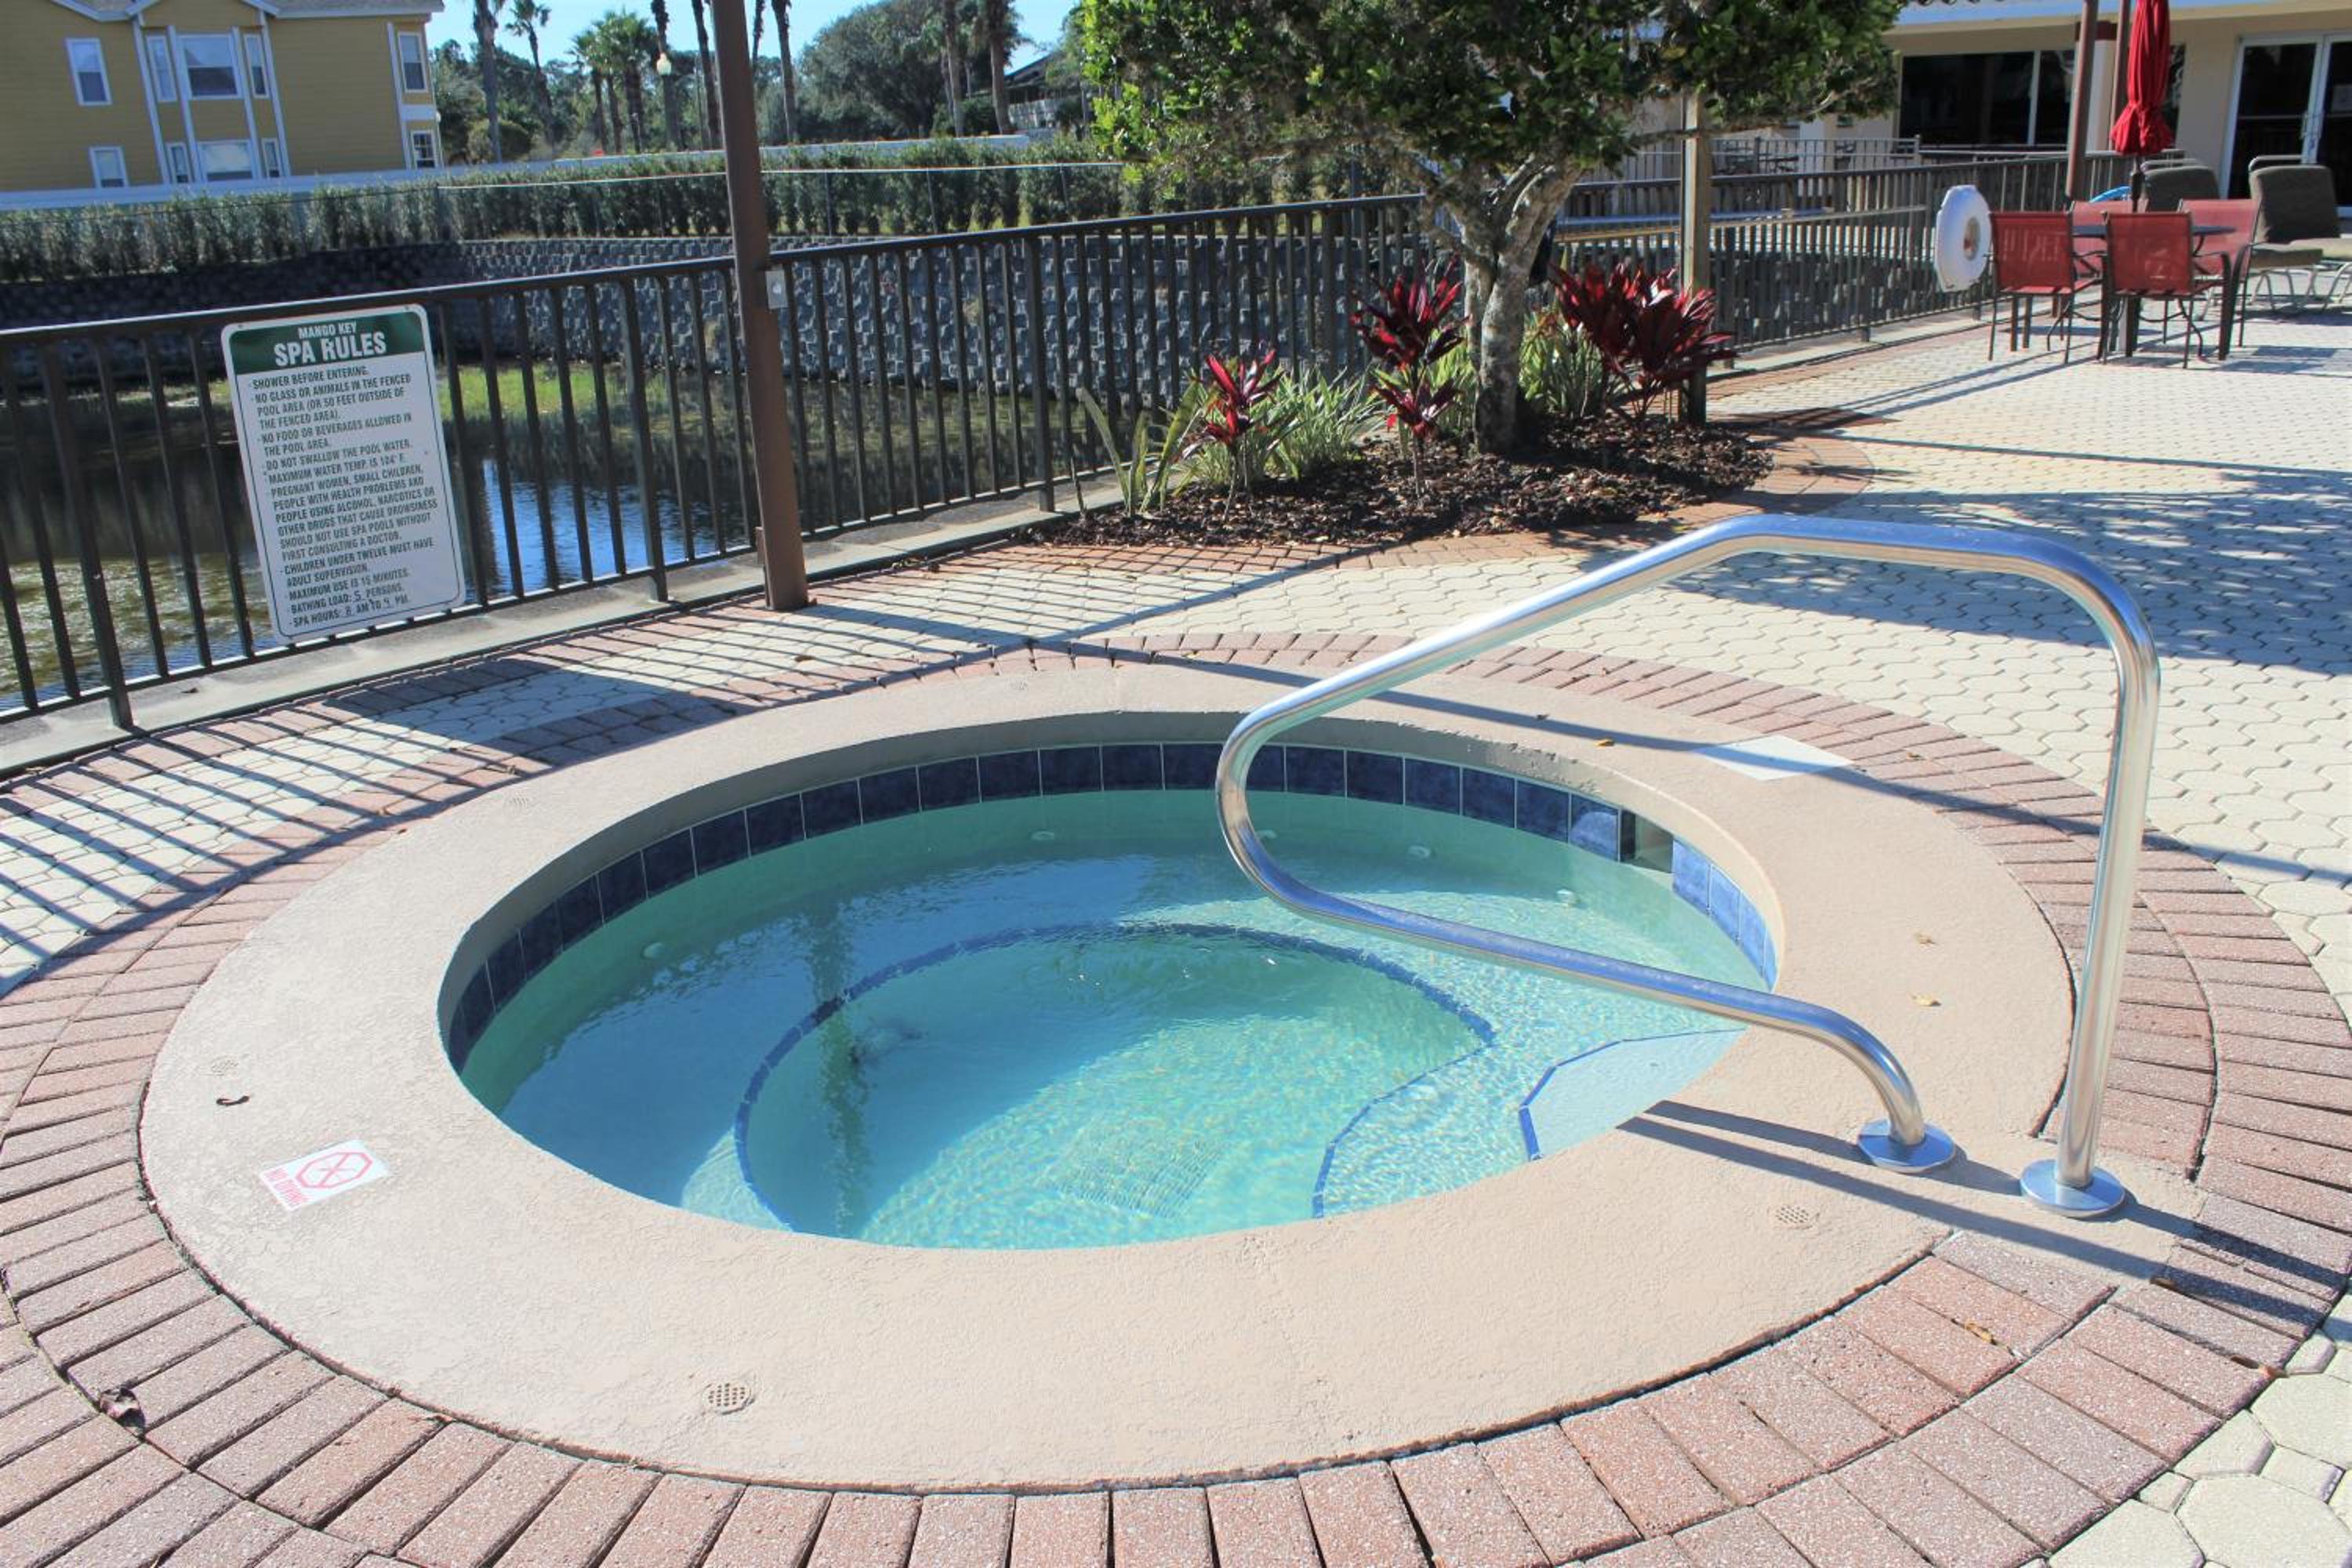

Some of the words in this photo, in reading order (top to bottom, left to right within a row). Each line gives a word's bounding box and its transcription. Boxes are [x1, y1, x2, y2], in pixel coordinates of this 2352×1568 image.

[298, 324, 336, 339] MANGO
[338, 321, 357, 334] KEY
[274, 339, 315, 366] SPA
[321, 332, 387, 361] RULES
[252, 376, 289, 390] SHOWER
[292, 371, 324, 384] BEFORE
[255, 394, 267, 404] NO
[270, 390, 296, 401] GLASS
[299, 387, 310, 397] OR
[312, 382, 350, 396] ANIMALS
[351, 381, 360, 390] IN
[363, 378, 378, 389] THE
[379, 374, 411, 387] FENCED
[257, 405, 280, 416] POOL
[281, 401, 304, 413] AREA
[307, 399, 321, 409] (OR
[323, 397, 335, 407] 50
[336, 394, 356, 405] FEET
[358, 389, 392, 402] OUTSIDE
[394, 387, 405, 397] OF
[260, 419, 275, 430] THE
[278, 413, 310, 426] FENCED
[262, 433, 274, 443] NO
[276, 429, 299, 441] FOOD
[301, 427, 313, 437] OR
[315, 419, 362, 435] BEVERAGES
[365, 414, 401, 427] ALLOWED
[404, 412, 412, 422] IN
[264, 445, 281, 456] THE
[282, 441, 305, 454] POOL
[266, 459, 278, 470] DO
[281, 456, 297, 468] NOT
[299, 450, 339, 465] SWALLOW
[343, 447, 358, 458] THE
[359, 443, 381, 456] POOL
[269, 468, 311, 484] MAXIMUM
[314, 463, 342, 477] WATER
[370, 458, 378, 467] IS
[270, 481, 314, 497] PREGNANT
[353, 470, 380, 484] SMALL
[274, 496, 305, 510] PEOPLE
[307, 492, 328, 504] WITH
[331, 487, 361, 500] HEALTH
[363, 479, 406, 495] PROBLEMS
[408, 476, 424, 487] AND
[276, 509, 307, 524] PEOPLE
[310, 504, 335, 517] USING
[378, 488, 422, 505] NARCOTICS
[424, 486, 435, 497] OR
[278, 522, 305, 536] OTHER
[307, 517, 336, 531] DRUGS
[337, 513, 358, 525] THAT
[359, 508, 385, 521] CAUSE
[387, 499, 437, 516] DROWSINESS
[280, 534, 313, 549] SHOULD
[314, 531, 331, 542] NOT
[333, 528, 349, 539] USE
[351, 524, 367, 535] SPA
[368, 519, 394, 532] POOLS
[397, 512, 431, 526] WITHOUT
[282, 549, 305, 561] FIRST
[307, 539, 358, 557] CONSULTING
[360, 537, 365, 546] A
[284, 558, 325, 575] CHILDREN
[328, 552, 354, 566] UNDER
[358, 546, 387, 561] TWELVE
[390, 541, 411, 554] MUST
[414, 537, 434, 549] HAVE
[286, 574, 312, 587] ADULT
[289, 583, 331, 600] MAXIMUM
[332, 579, 349, 591] USE
[350, 578, 358, 588] IS
[291, 598, 326, 614] BATHING
[293, 615, 309, 627] SPA
[357, 603, 369, 613] AM
[369, 600, 382, 611] TO
